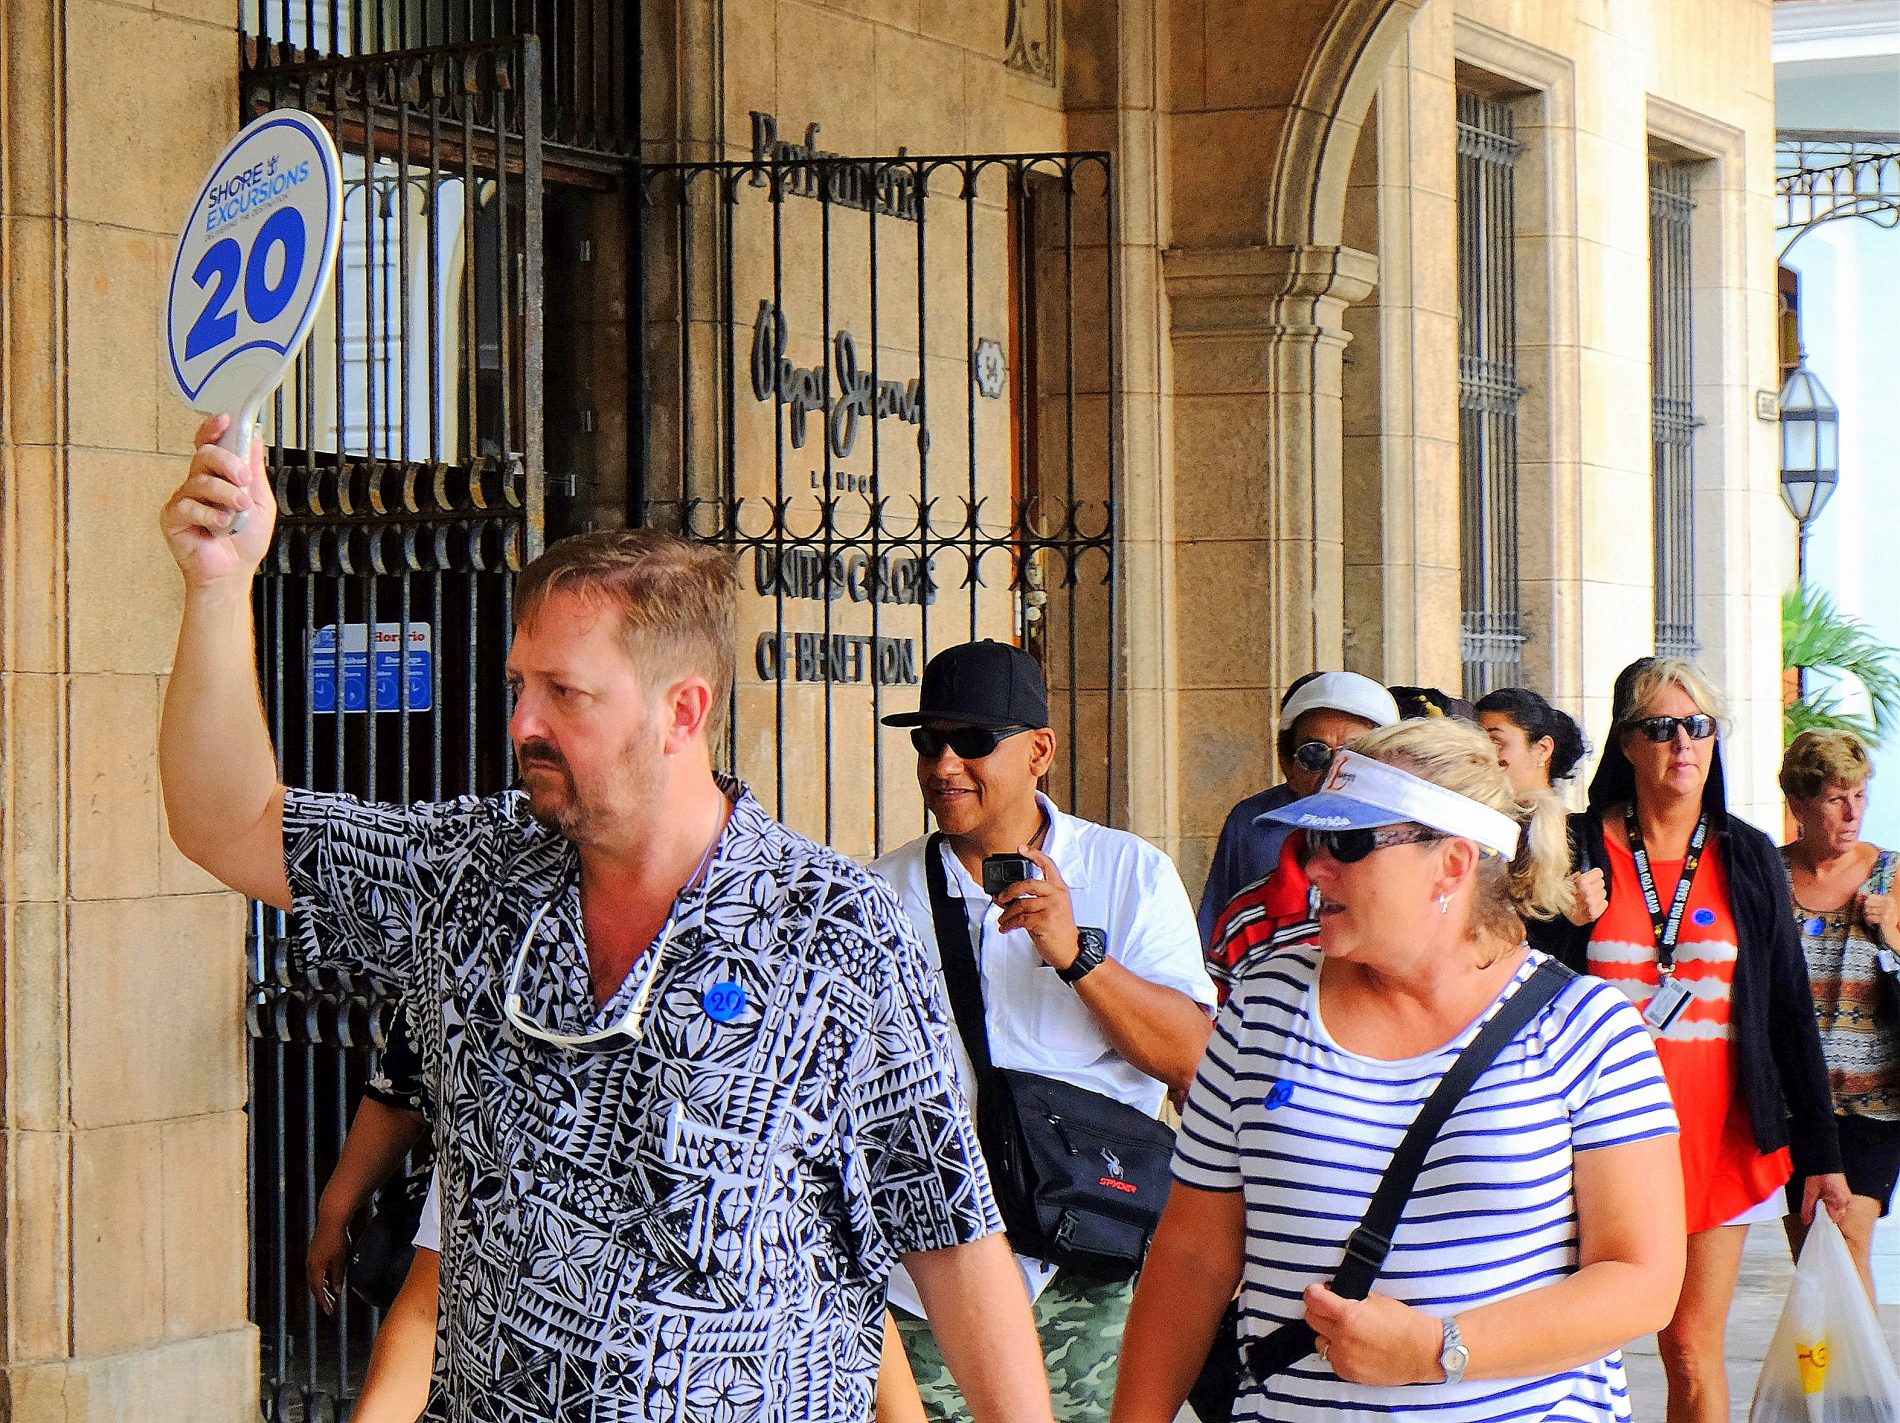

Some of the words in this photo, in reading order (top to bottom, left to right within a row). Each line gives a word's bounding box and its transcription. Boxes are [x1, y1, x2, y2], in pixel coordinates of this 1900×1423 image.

[205, 160, 310, 233] EXCURSIONS
[207, 161, 264, 209] SHORE
[184, 206, 307, 362] 20
[810, 470, 878, 494] LNDO
[754, 545, 846, 602] UNITED
[848, 554, 937, 606] COLORS
[374, 630, 425, 642] Horio
[755, 630, 794, 682] OF
[1640, 873, 1654, 892] YOU
[1669, 901, 1686, 919] YOU
[711, 990, 742, 1012] 20
[1099, 1177, 1138, 1194] SPYDER
